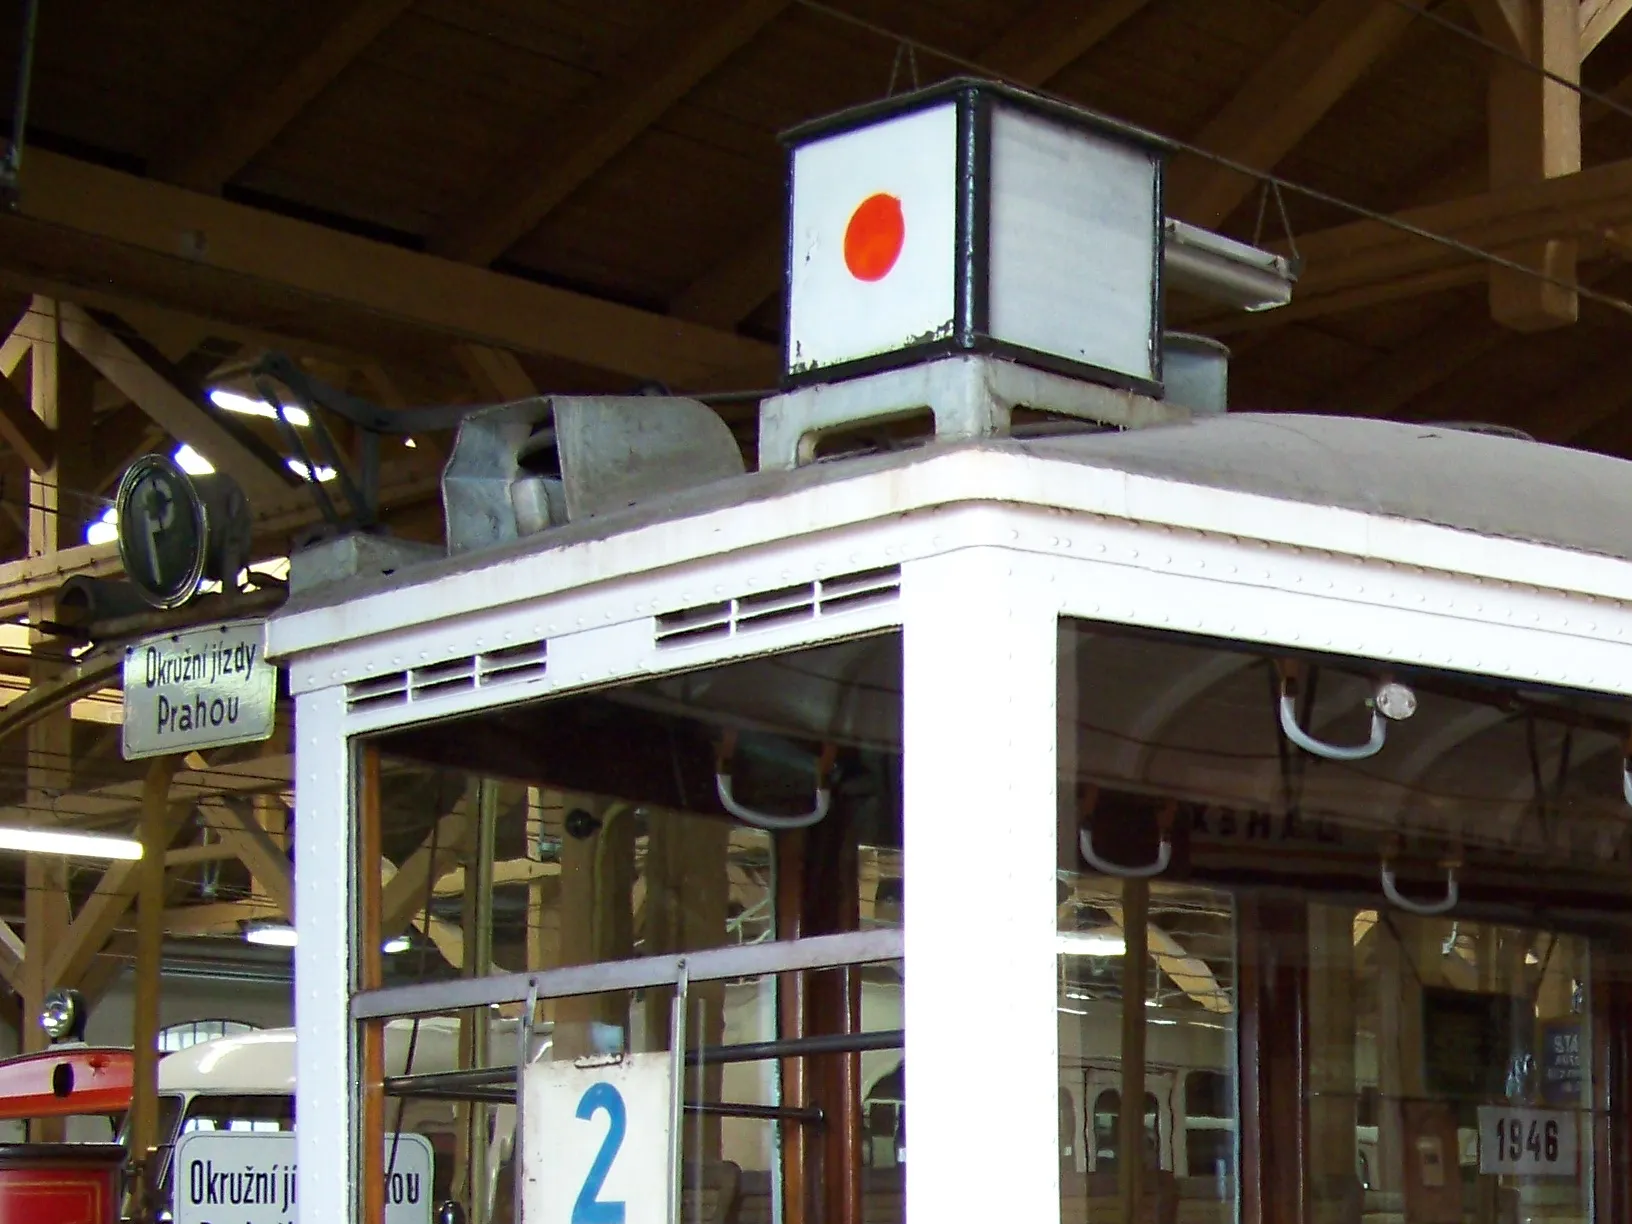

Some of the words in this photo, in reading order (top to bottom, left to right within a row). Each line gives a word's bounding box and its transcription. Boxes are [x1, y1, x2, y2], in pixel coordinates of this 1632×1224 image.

[146, 643, 208, 688] Okružní
[211, 640, 257, 684] jízdy
[157, 693, 240, 735] Prahou
[1497, 1118, 1559, 1162] 1946
[190, 1159, 277, 1205] Okružní
